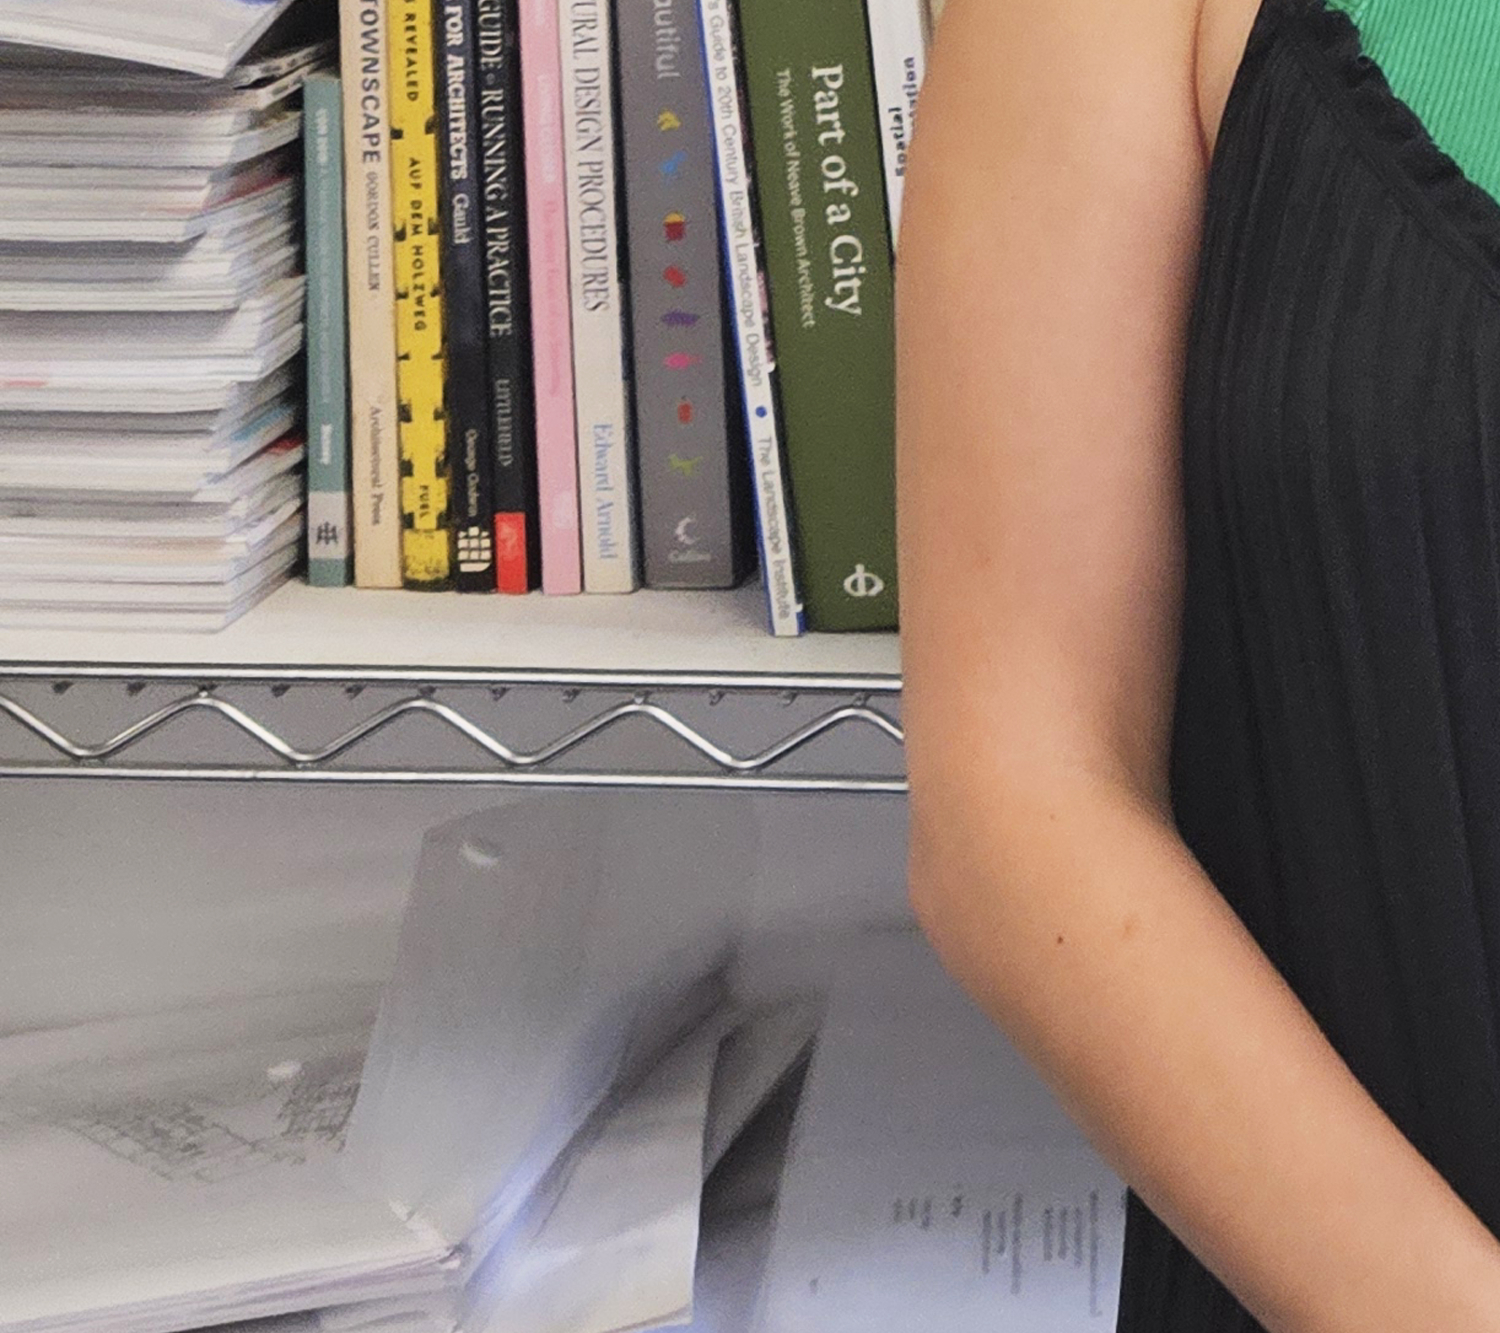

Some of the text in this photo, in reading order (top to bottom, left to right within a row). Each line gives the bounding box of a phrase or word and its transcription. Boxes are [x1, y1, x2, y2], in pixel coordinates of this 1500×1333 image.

[445, 6, 464, 46] FOR
[709, 15, 728, 62] Guide
[404, 12, 420, 102] REVEALED
[714, 66, 729, 81] to
[447, 54, 468, 180] ARCHITECTS
[574, 68, 606, 152] DESIGN
[716, 85, 735, 120] 20th
[408, 157, 422, 190] AUF
[481, 89, 508, 200] RUNNING
[722, 126, 743, 186] Century
[365, 171, 381, 230] GORDON
[411, 200, 424, 236] DEM
[486, 205, 508, 220] A
[729, 190, 750, 239] British
[776, 68, 816, 328] The Work of Neave Brown Architect
[811, 63, 867, 315] Part of a City
[452, 194, 471, 245] Gauld
[578, 160, 610, 312] PROCEDURES
[367, 234, 382, 290] CULLEN
[412, 245, 427, 332] HOLZWEG
[486, 226, 513, 338] PRACTICE
[735, 241, 760, 328] Landscape
[743, 330, 766, 387] Design
[594, 423, 615, 491] Edward
[757, 437, 774, 466] The
[596, 498, 618, 560] Arnold
[760, 470, 784, 555] Landscape
[772, 559, 792, 620] Institute
